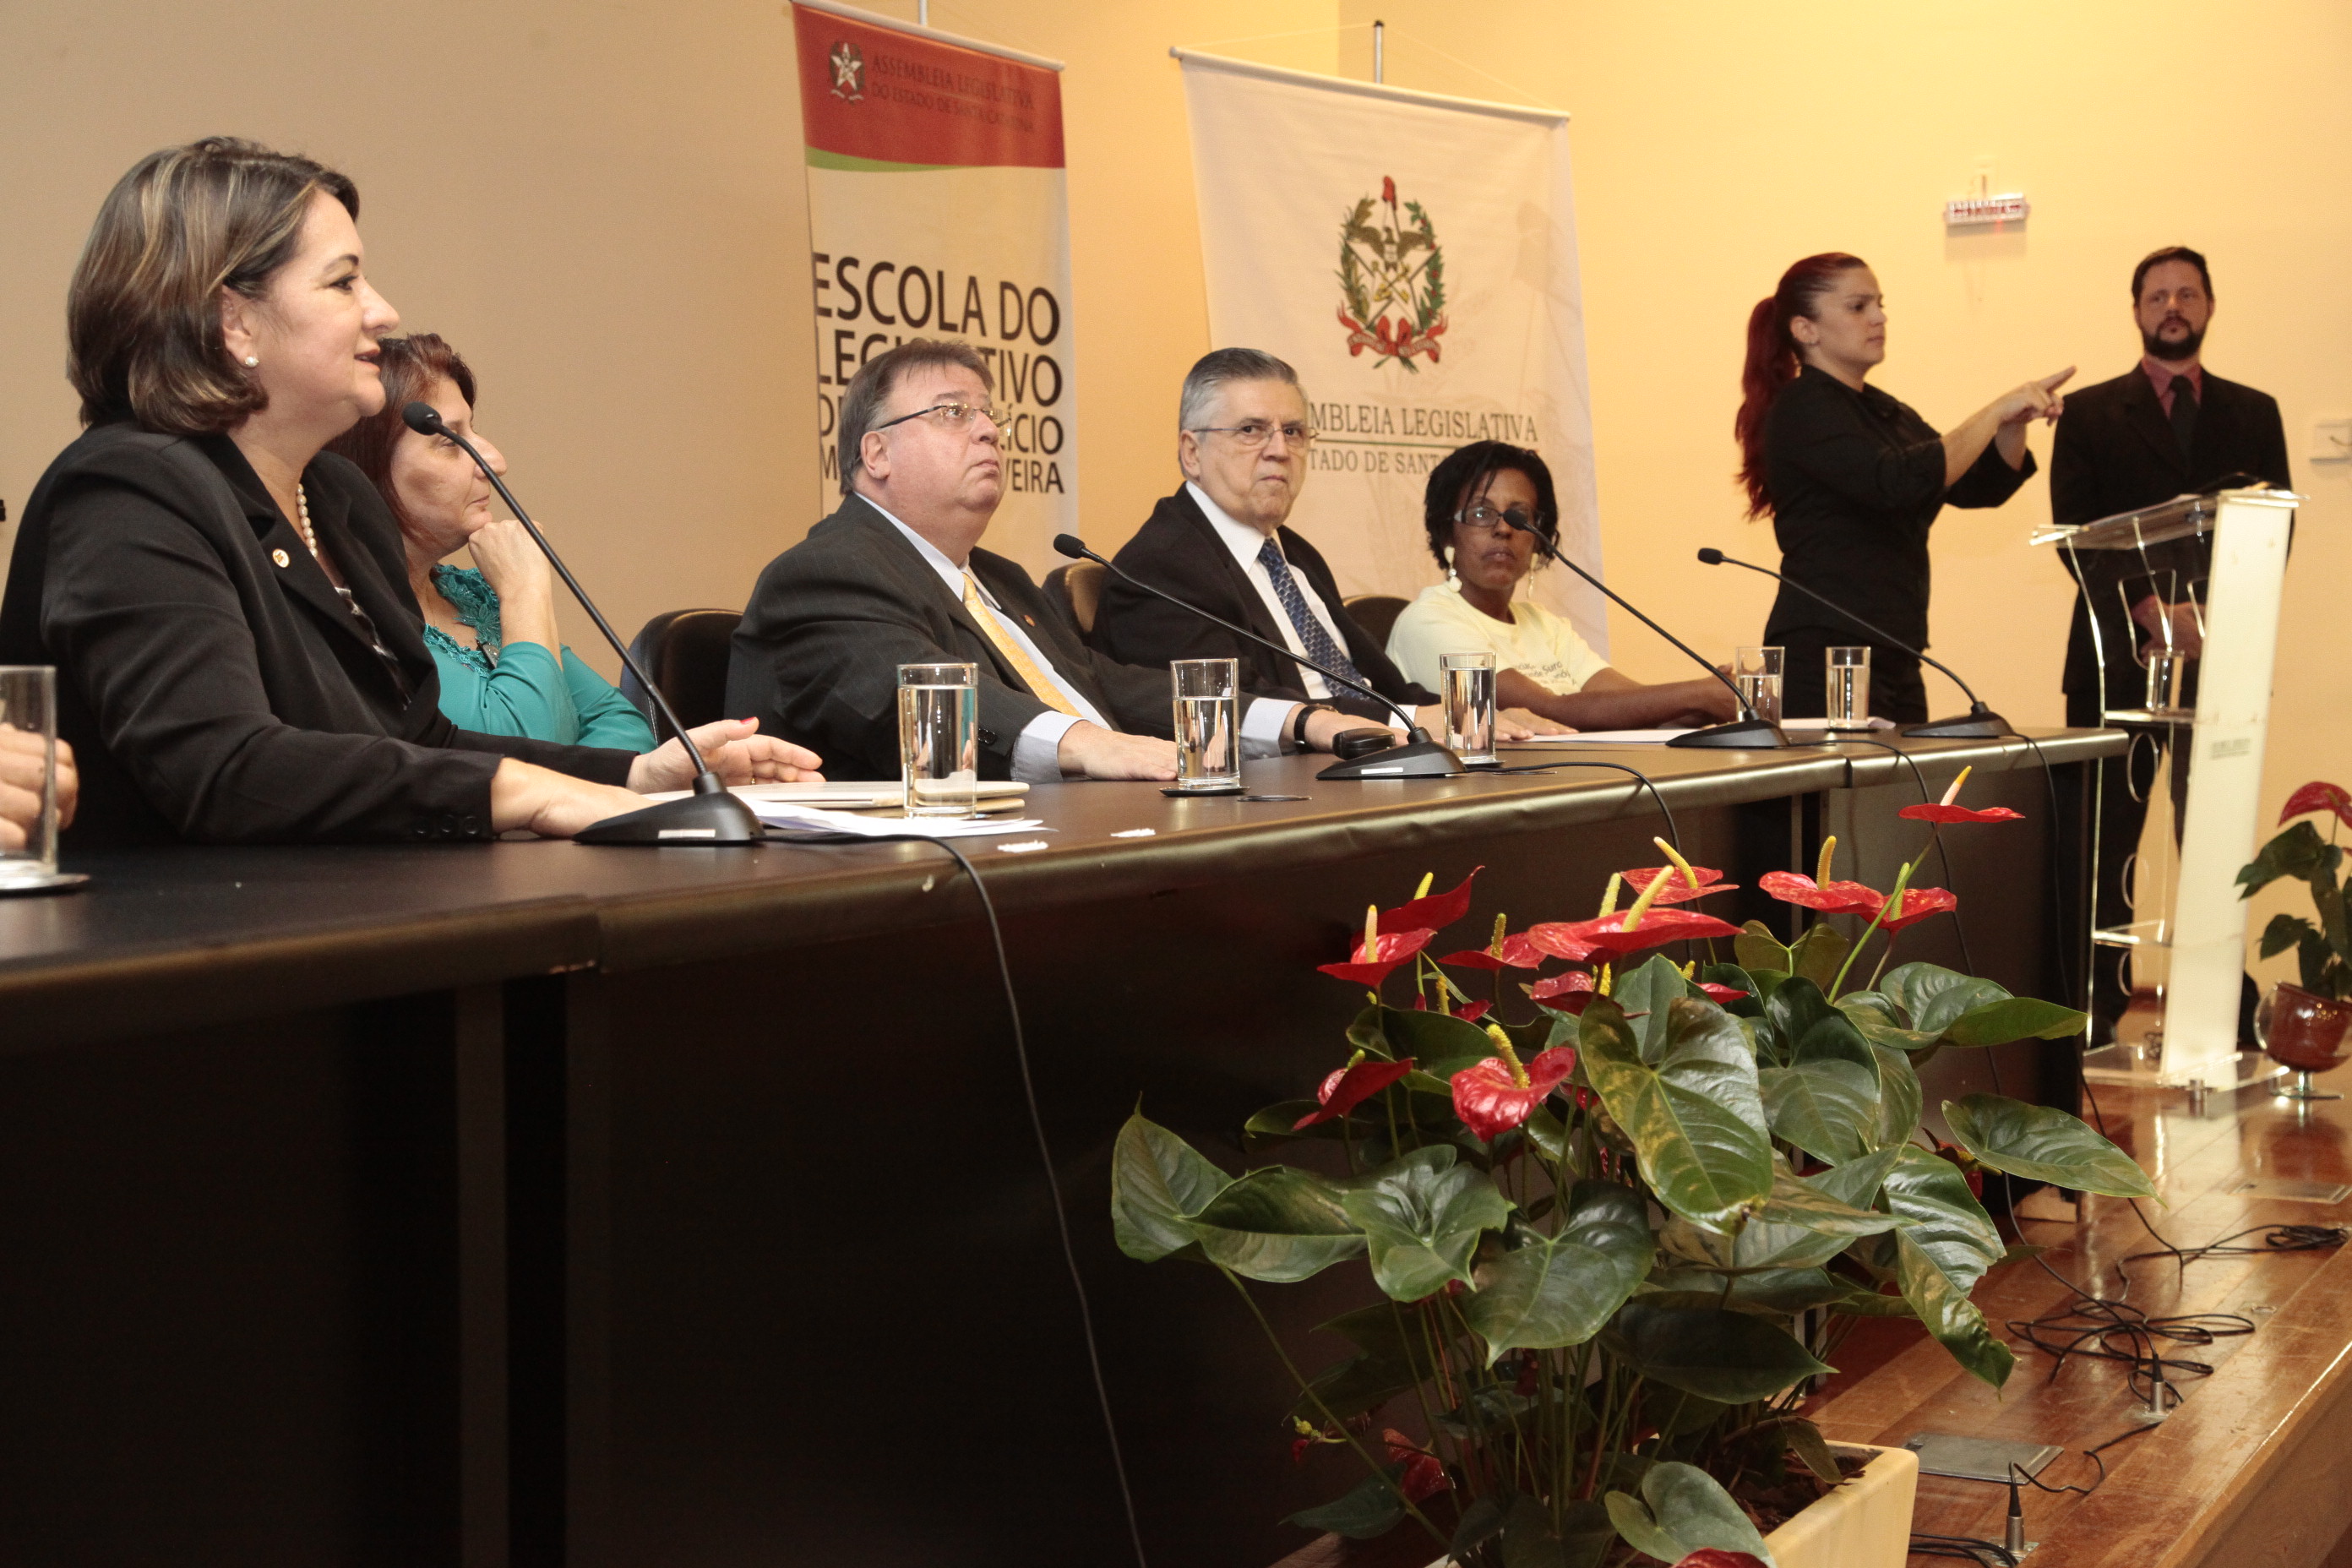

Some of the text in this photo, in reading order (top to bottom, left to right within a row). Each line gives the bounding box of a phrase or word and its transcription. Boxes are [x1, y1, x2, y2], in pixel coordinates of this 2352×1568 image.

[812, 253, 1060, 346] ESCOLA DO
[1309, 402, 1538, 442] MBLEIA LEGISLATIVA
[1308, 449, 1445, 475] TADO DE SANT
